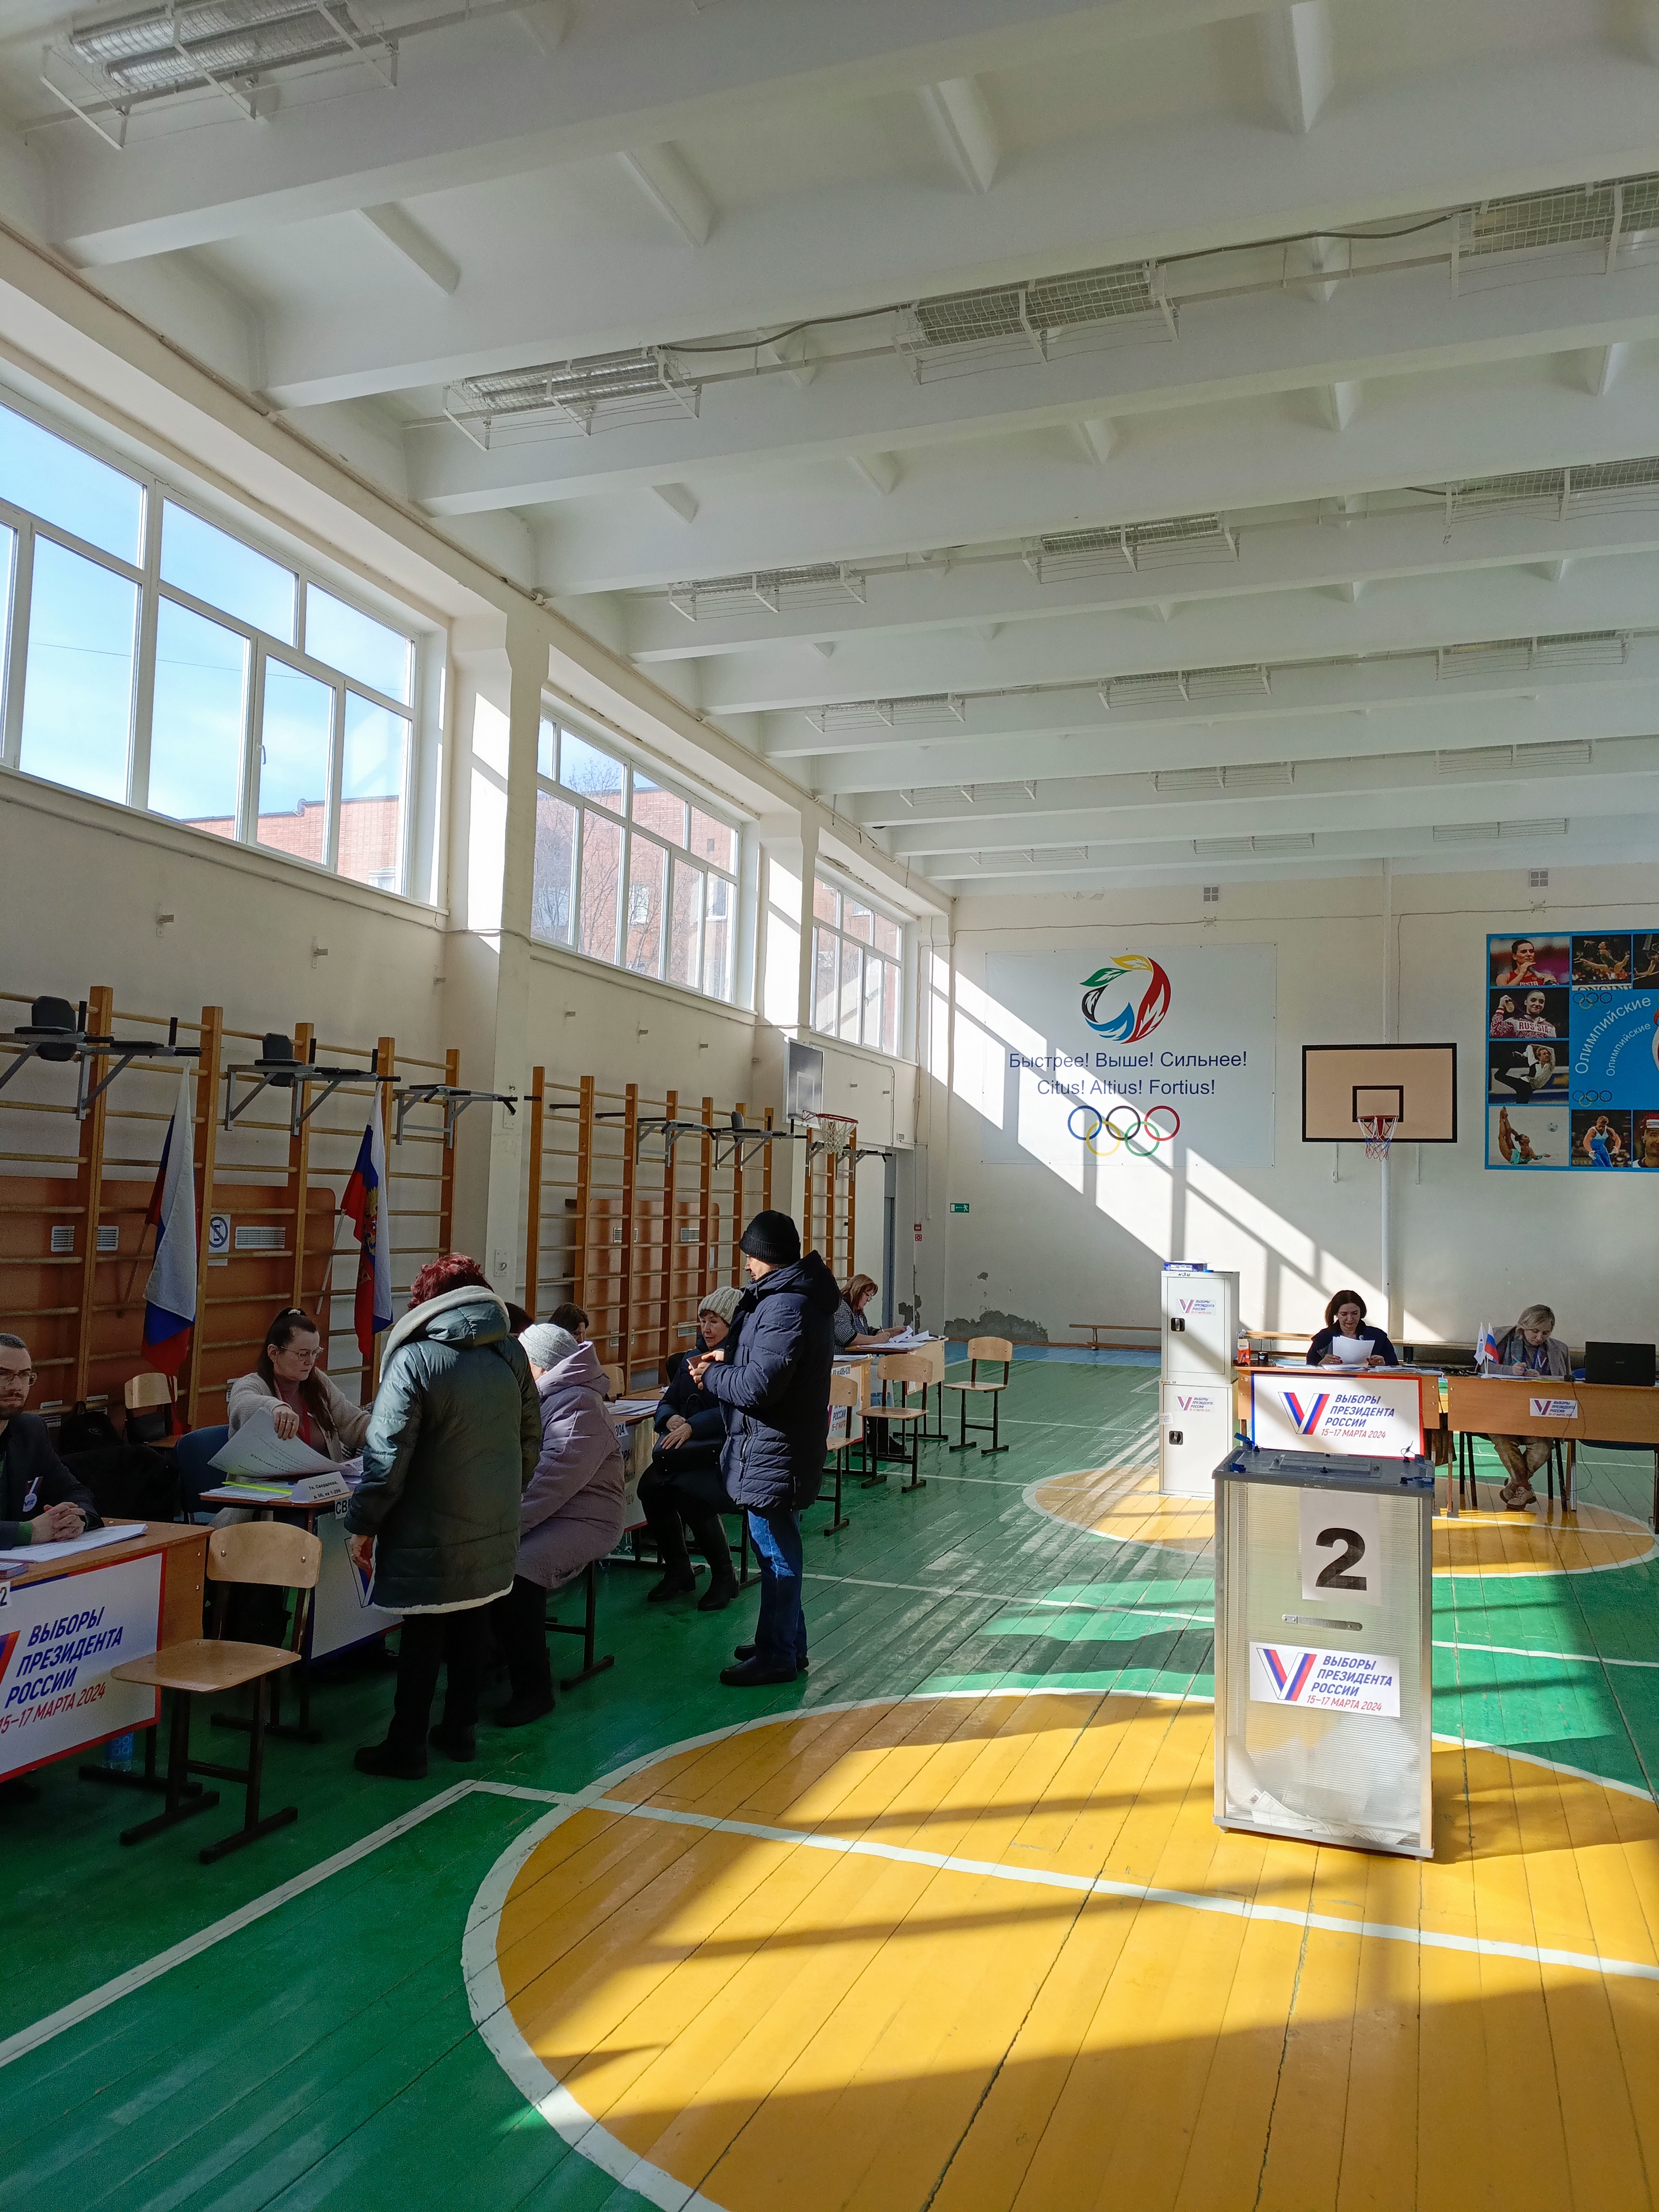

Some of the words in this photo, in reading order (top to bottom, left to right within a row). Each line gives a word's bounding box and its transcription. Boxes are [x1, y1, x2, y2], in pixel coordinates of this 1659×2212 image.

[1575, 998, 1651, 1074] Олимпийские
[1606, 1023, 1651, 1076] Олимпийские
[1010, 1053, 1089, 1069] Быстрее!
[1095, 1052, 1153, 1068] Выше!
[1160, 1051, 1247, 1067] Сильнее!
[1037, 1080, 1084, 1095] Citus!
[1090, 1080, 1142, 1094] Altius!
[1149, 1079, 1215, 1094] Fortius!
[1335, 1394, 1381, 1405] ВЫБОРЫ
[1330, 1406, 1395, 1417] ПРЕЗИДЕНТА
[1325, 1418, 1367, 1428] РОССИИ
[1342, 1430, 1367, 1438] МАРТА
[1368, 1431, 1386, 1439] 2024
[1315, 1527, 1367, 1591] 2
[27, 1606, 105, 1647] ВЫБОРЫ
[16, 1626, 124, 1678] ПРЕЗИДЕНТА
[1322, 1656, 1377, 1671] ВЫБОРЫ
[1317, 1669, 1393, 1686] ПРЕЗИДЕНТА
[4, 1667, 78, 1709] РОССИИ
[1311, 1682, 1360, 1696] РОССИИ
[33, 1693, 76, 1723] МАРТА
[76, 1682, 106, 1707] 2024
[1331, 1698, 1359, 1709] МАРТА
[1361, 1701, 1382, 1712] 2024
